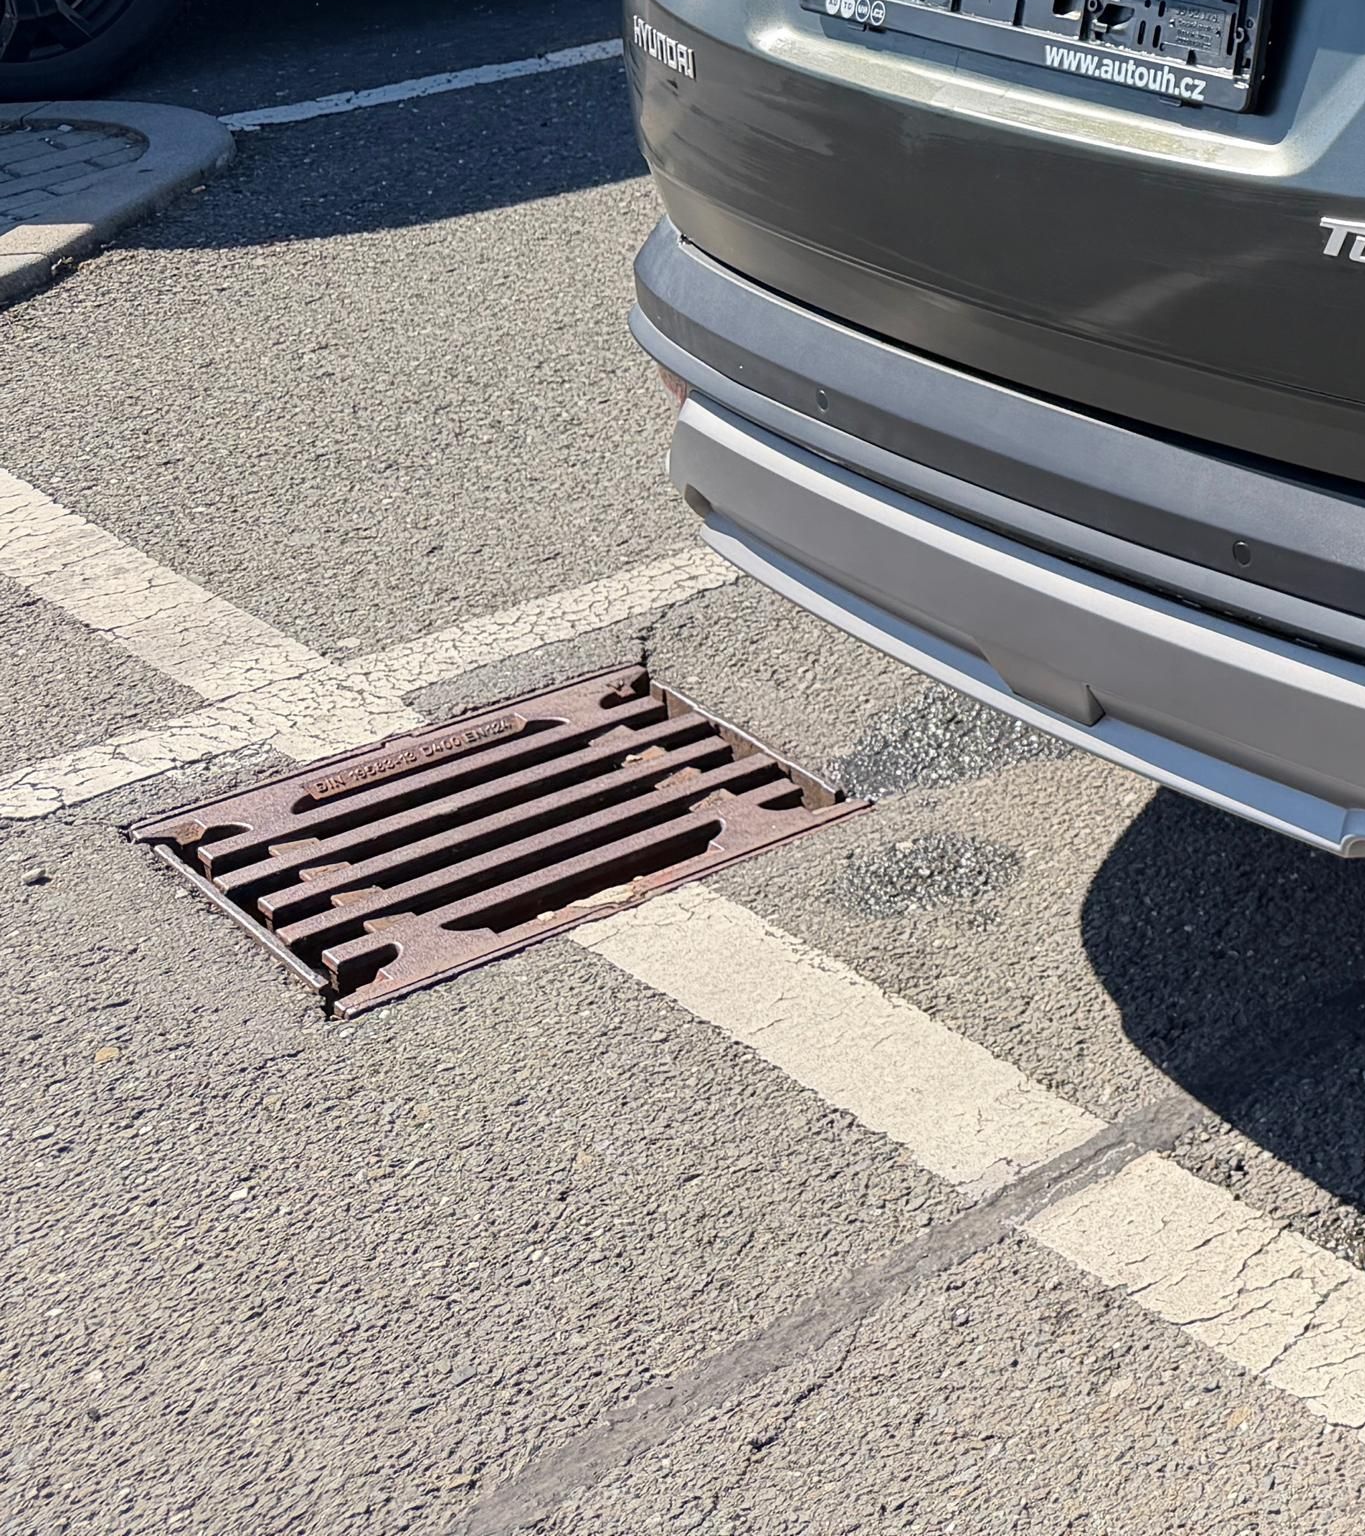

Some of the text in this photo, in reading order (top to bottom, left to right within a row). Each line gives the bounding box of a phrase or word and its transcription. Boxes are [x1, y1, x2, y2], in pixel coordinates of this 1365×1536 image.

[633, 15, 695, 80] HYUNDAI
[1045, 43, 1207, 101] www.autouh.cz
[315, 774, 346, 793] DIN
[421, 735, 462, 757] D400
